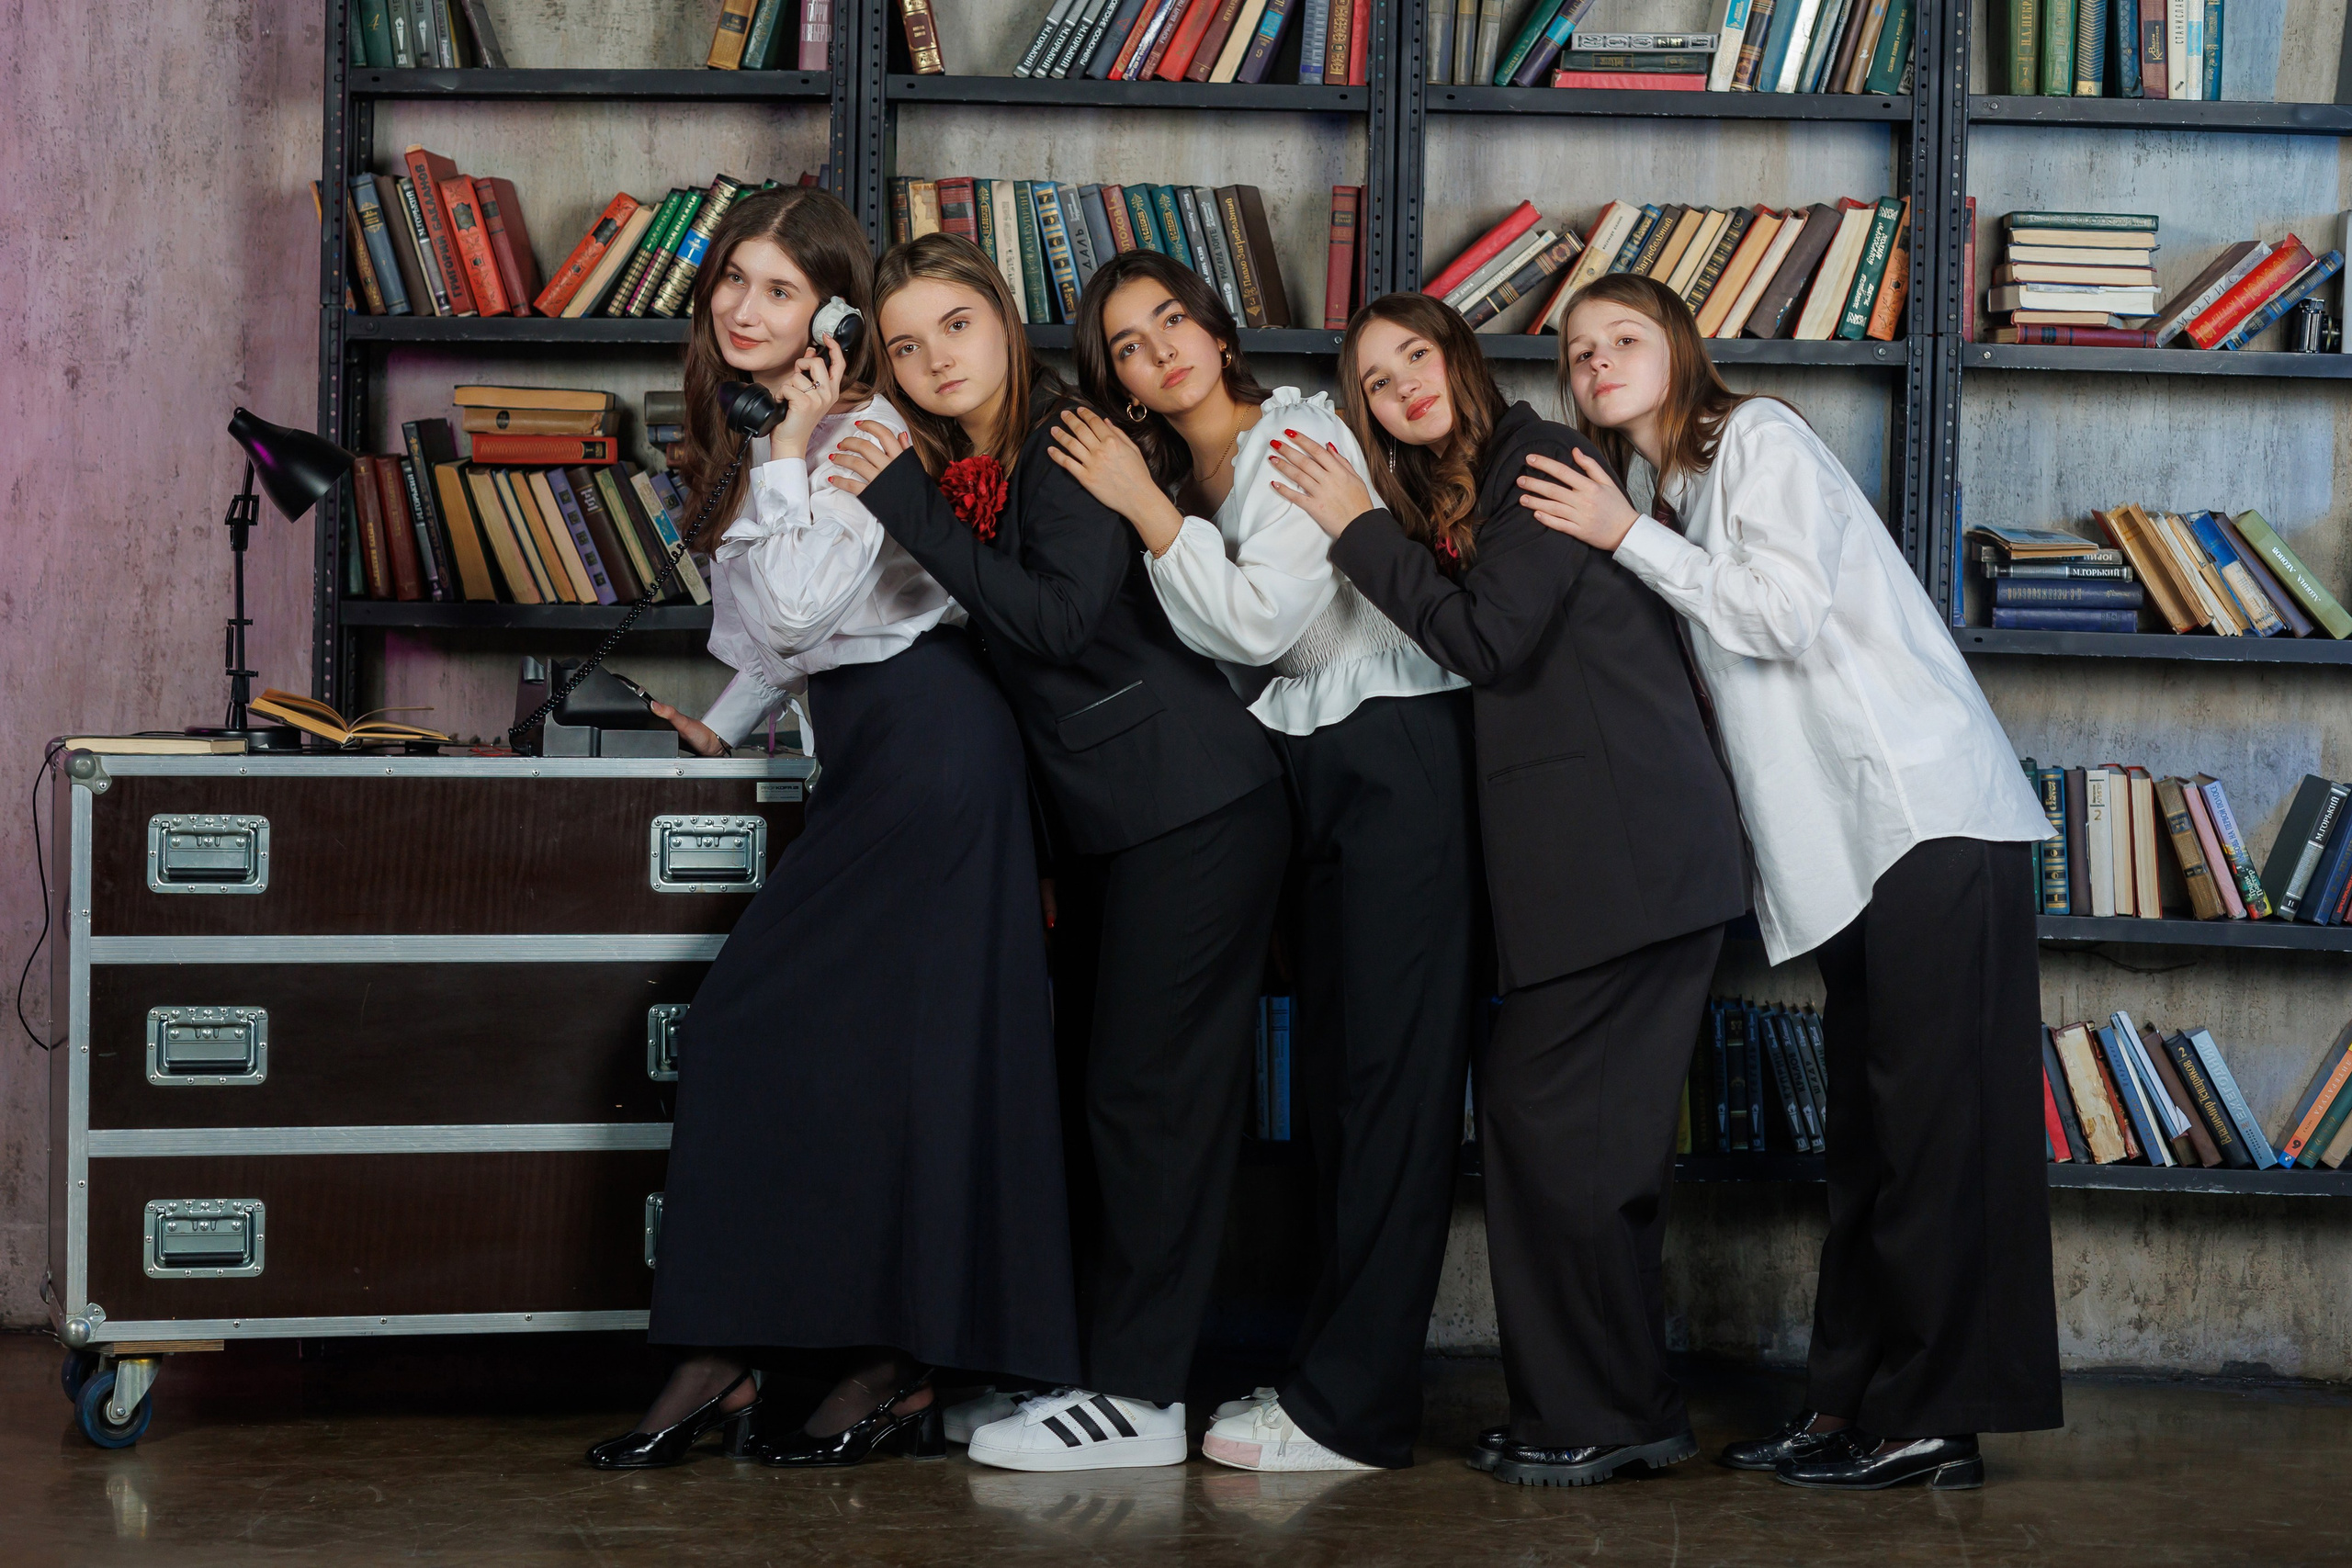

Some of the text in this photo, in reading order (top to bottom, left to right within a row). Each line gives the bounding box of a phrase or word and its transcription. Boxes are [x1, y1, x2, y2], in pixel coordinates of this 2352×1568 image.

[1023, 25, 1053, 67] М.ГОРЬКИЙ
[1042, 27, 1070, 69] М.ГОРЬКИЙ
[1061, 25, 1089, 68] М.ГОРЬКИЙ
[1080, 0, 1117, 66] ОВЕТСКИЕ КОСМОНАВТЫ
[2022, 67, 2029, 75] 7
[414, 164, 463, 299] ГРИГОРИЙ БАКЛАНОВ
[1076, 228, 1092, 271] ДАЛЬ
[1114, 209, 1132, 254] ЛОХОВ
[1225, 197, 1251, 287] Павло Загребельный
[1634, 218, 1673, 275] Загребельный
[1210, 230, 1227, 279] РИХАРД ЗОРГЕ
[1250, 297, 1256, 305] 3
[2177, 273, 2239, 328] МОРИС
[2073, 568, 2120, 577] М.ГОРЬКИЙ
[2272, 547, 2322, 602] ЛЕОНИД ЛЕОНОВ
[2094, 809, 2102, 820] 2
[2208, 784, 2224, 808] ПОЛОСЕ
[2217, 808, 2233, 830] ПЕРВОЙ
[2227, 829, 2236, 840] НА
[2315, 796, 2340, 841] М.ГОРЬКИЙ
[1792, 1053, 1806, 1092] КРЫЛОВ
[2178, 1047, 2187, 1057] 2
[1773, 1052, 1792, 1100] КУПРИН
[1805, 1060, 1821, 1094] ШАДР
[2199, 1042, 2247, 1120] ЕЖЕГОДНИК
[2314, 1059, 2352, 1115] ЛИТЕРАТУРА
[2201, 1099, 2235, 1145] Владимир
